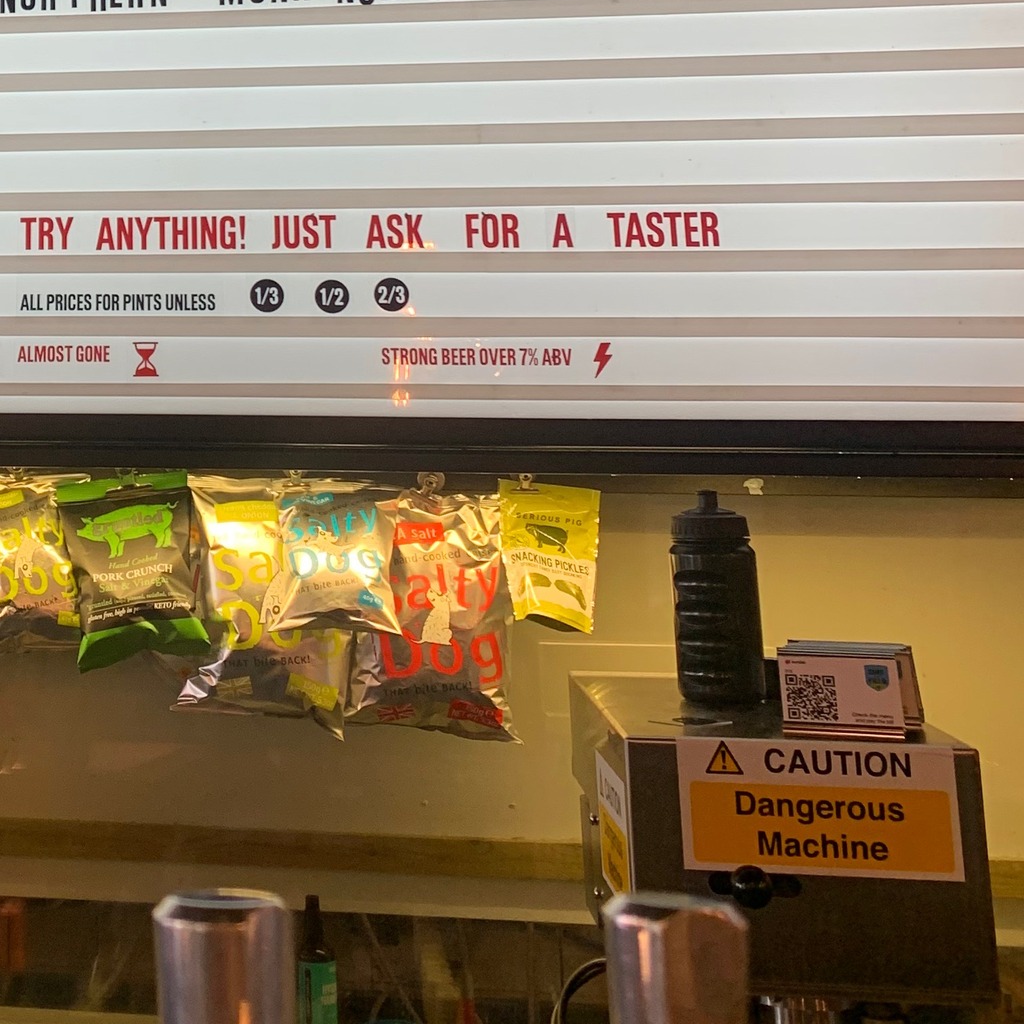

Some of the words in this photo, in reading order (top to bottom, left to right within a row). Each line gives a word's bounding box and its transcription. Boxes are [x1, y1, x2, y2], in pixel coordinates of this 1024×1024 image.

[20, 216, 74, 251] TRY
[95, 215, 246, 251] ANYTHING!
[271, 213, 337, 250] JUST
[366, 212, 425, 249] ASK
[465, 211, 520, 249] FOR
[552, 213, 574, 248] A
[606, 211, 720, 248] TASTER
[20, 293, 44, 311] ALL
[46, 293, 92, 311] PRICES
[95, 293, 120, 311] FOR
[123, 293, 162, 311] PINTS
[165, 293, 216, 311] UNLESS
[17, 345, 73, 363] ALMOST
[75, 345, 111, 363] GONE
[381, 347, 438, 366] STRONG
[441, 347, 476, 366] BEER
[479, 347, 517, 366] OVER
[518, 347, 539, 366] 7%
[541, 348, 572, 366] ABV
[516, 512, 560, 523] SERIOUS
[565, 518, 582, 526] PIG
[92, 573, 124, 582] PORK
[126, 563, 173, 579] CRUNCH
[511, 552, 553, 567] SNACKING
[555, 559, 589, 575] PICKLES
[280, 654, 311, 666] BACK!
[378, 631, 503, 684] Dog
[763, 748, 912, 778] CAUTION
[734, 790, 905, 825] Dangerous
[757, 831, 889, 861] Machine
